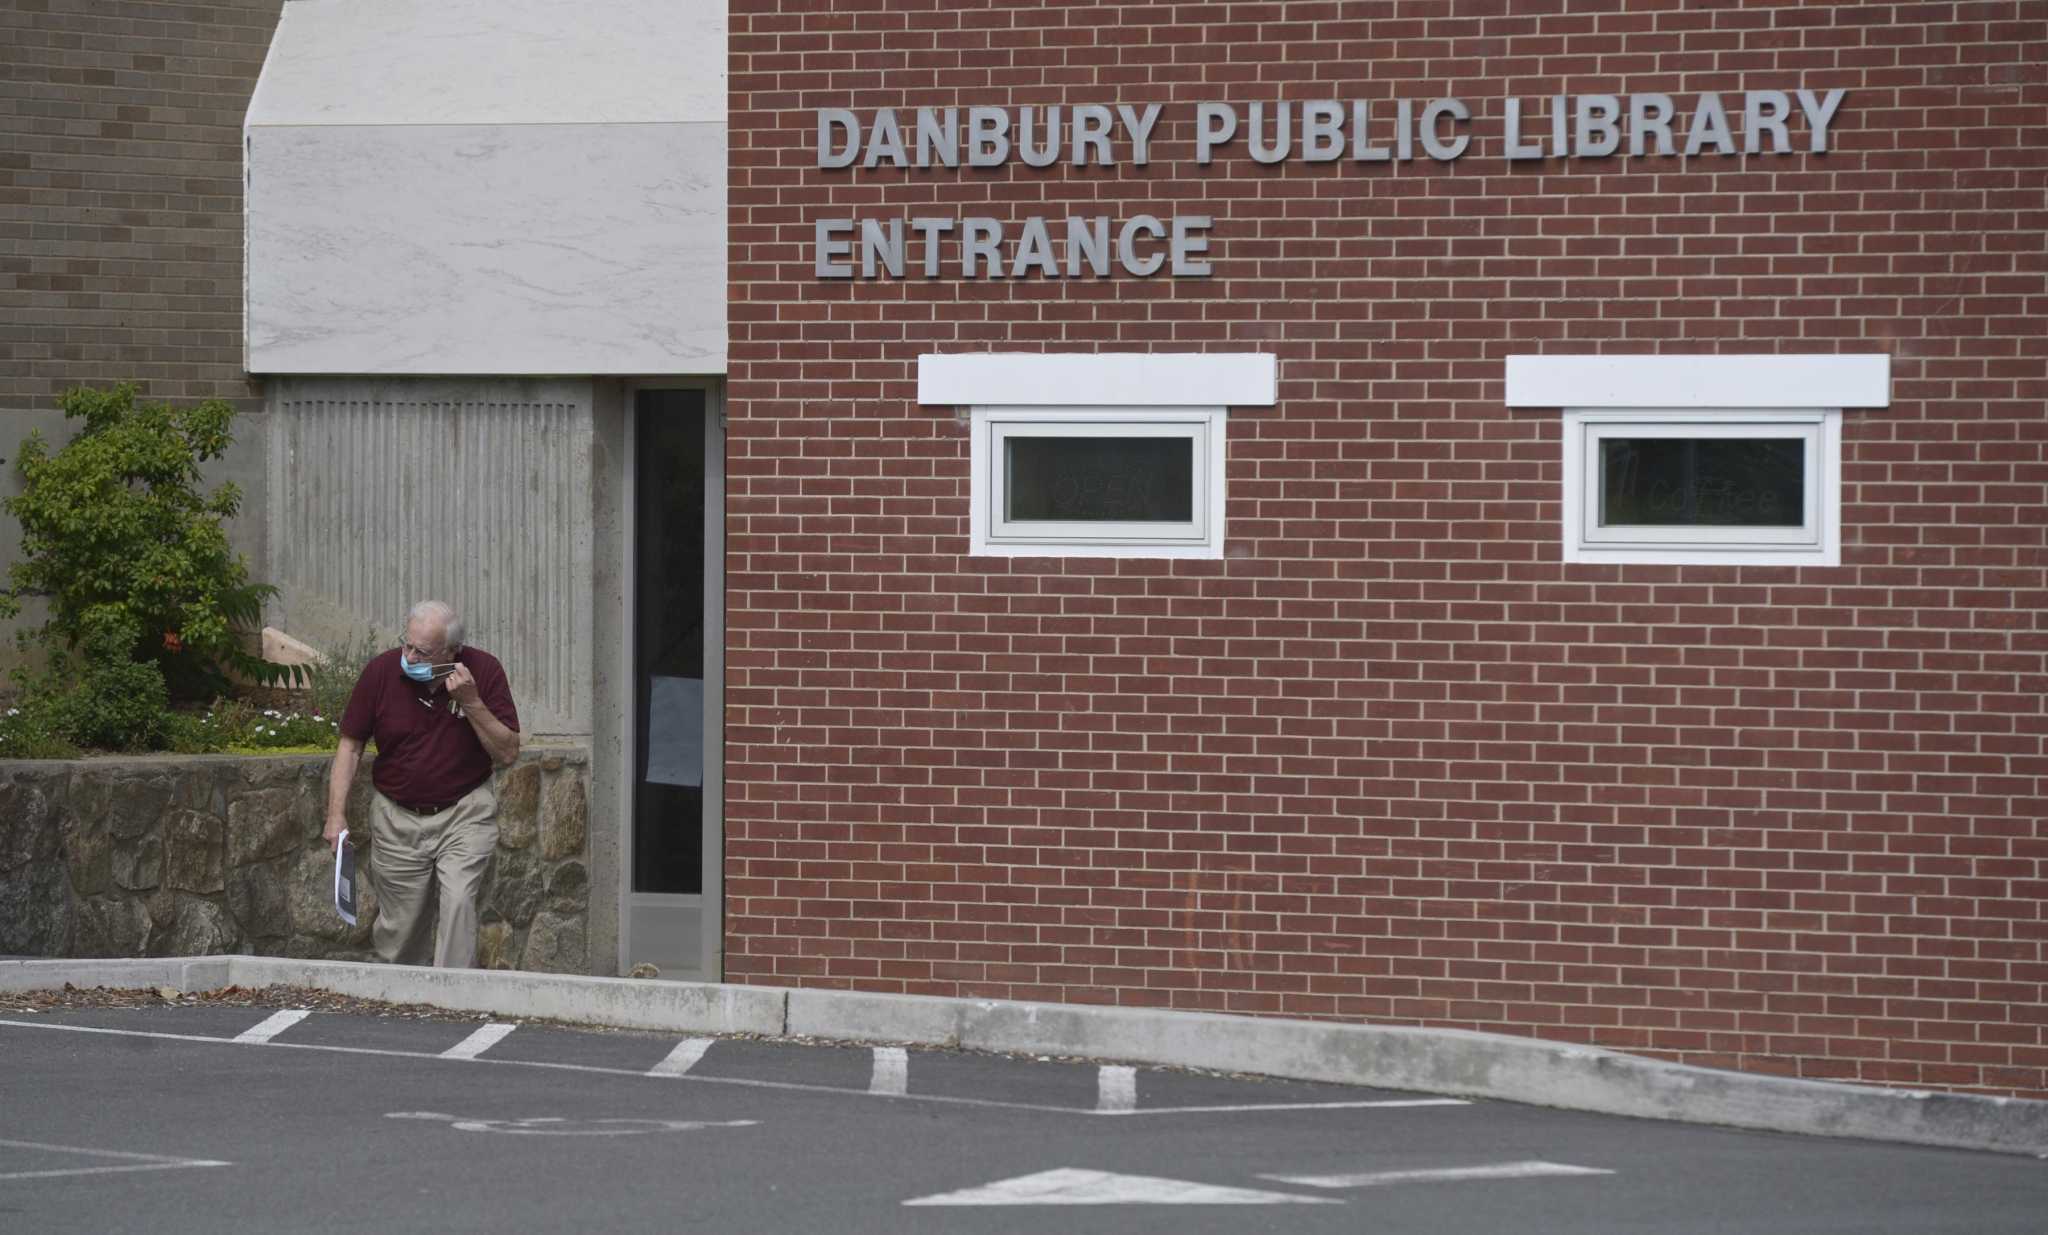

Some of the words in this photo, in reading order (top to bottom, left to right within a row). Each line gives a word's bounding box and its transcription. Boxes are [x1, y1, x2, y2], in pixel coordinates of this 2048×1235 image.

[816, 103, 1164, 169] DANBURY
[1196, 97, 1471, 165] PUBLIC
[1503, 89, 1845, 160] LIBRARY
[815, 215, 1214, 279] ENTRANCE
